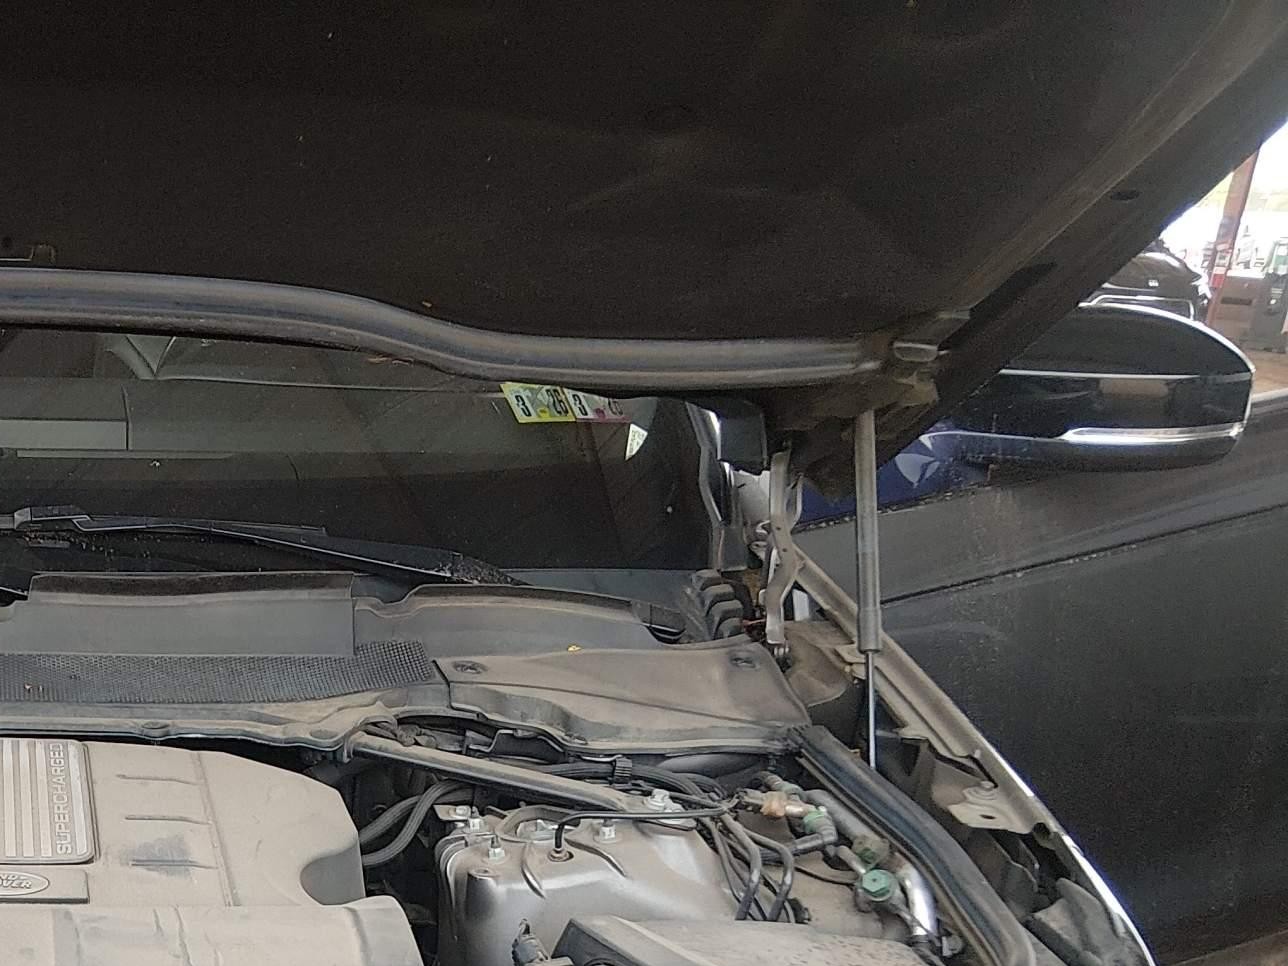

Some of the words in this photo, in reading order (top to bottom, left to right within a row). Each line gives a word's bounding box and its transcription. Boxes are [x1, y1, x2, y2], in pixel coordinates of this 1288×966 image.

[515, 394, 532, 417] 3
[545, 388, 569, 416] 26
[572, 393, 588, 416] 3
[49, 742, 72, 854] SUPERCHARGED
